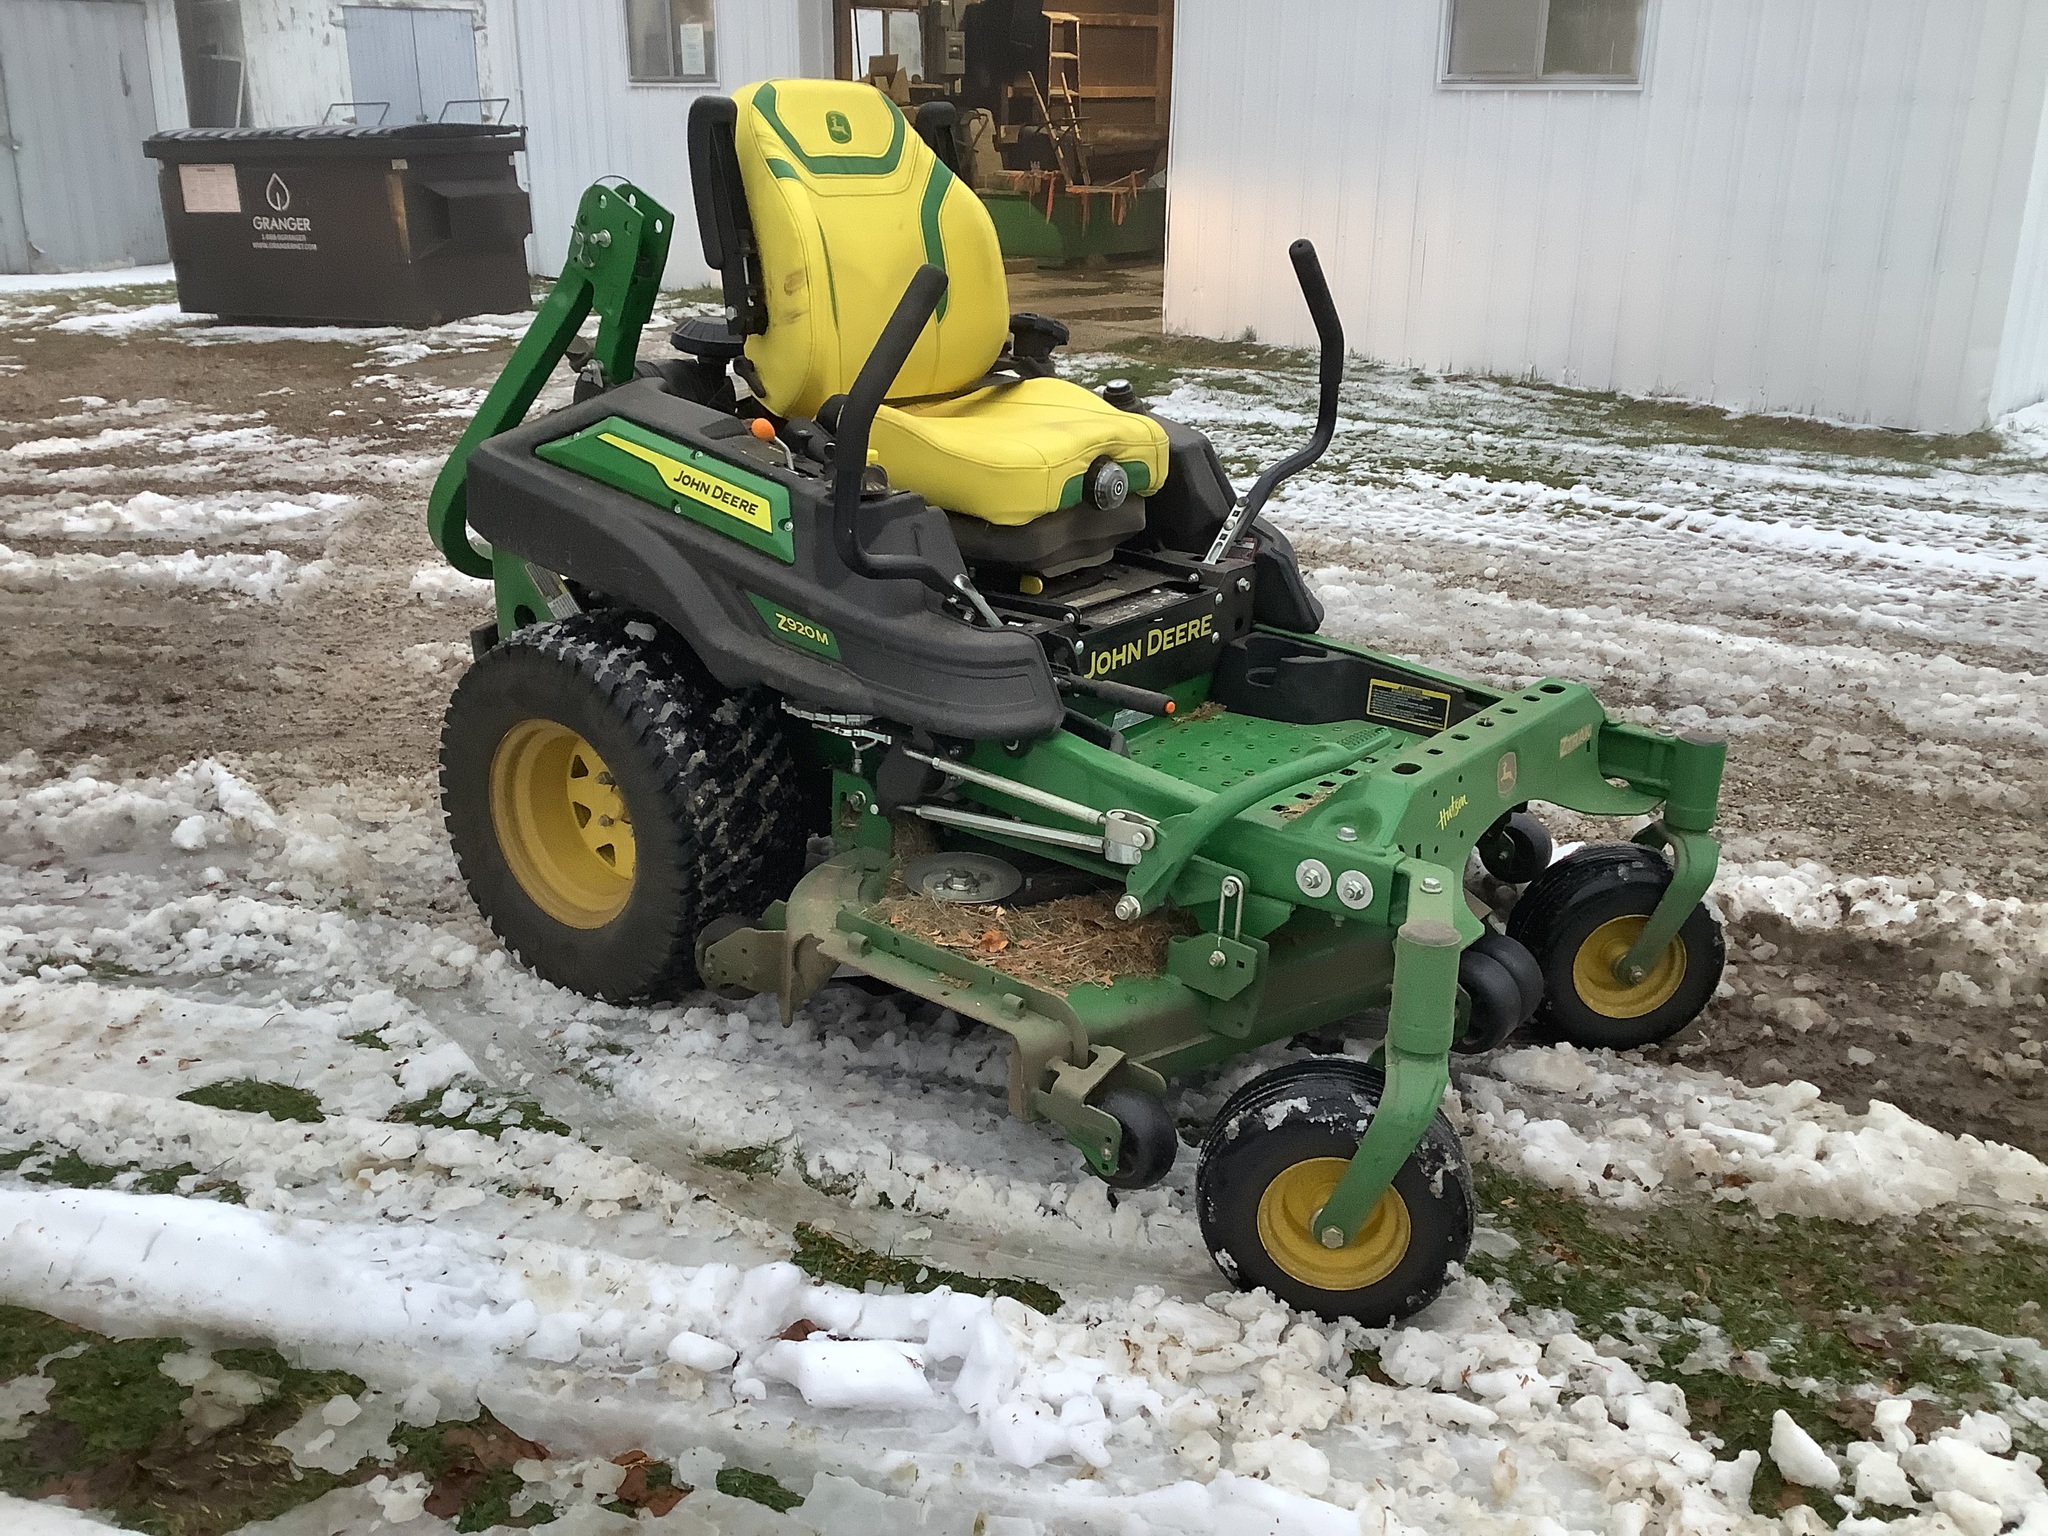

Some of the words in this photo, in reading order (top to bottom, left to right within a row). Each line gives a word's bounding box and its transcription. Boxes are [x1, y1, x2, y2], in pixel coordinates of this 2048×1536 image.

[252, 215, 311, 231] GRANGER
[673, 470, 711, 495] JOHN
[711, 485, 759, 516] DEERE
[775, 612, 829, 646] Z920M
[1083, 638, 1142, 679] JOHN
[1146, 613, 1213, 657] DEERE
[1436, 794, 1469, 831] Hutson
